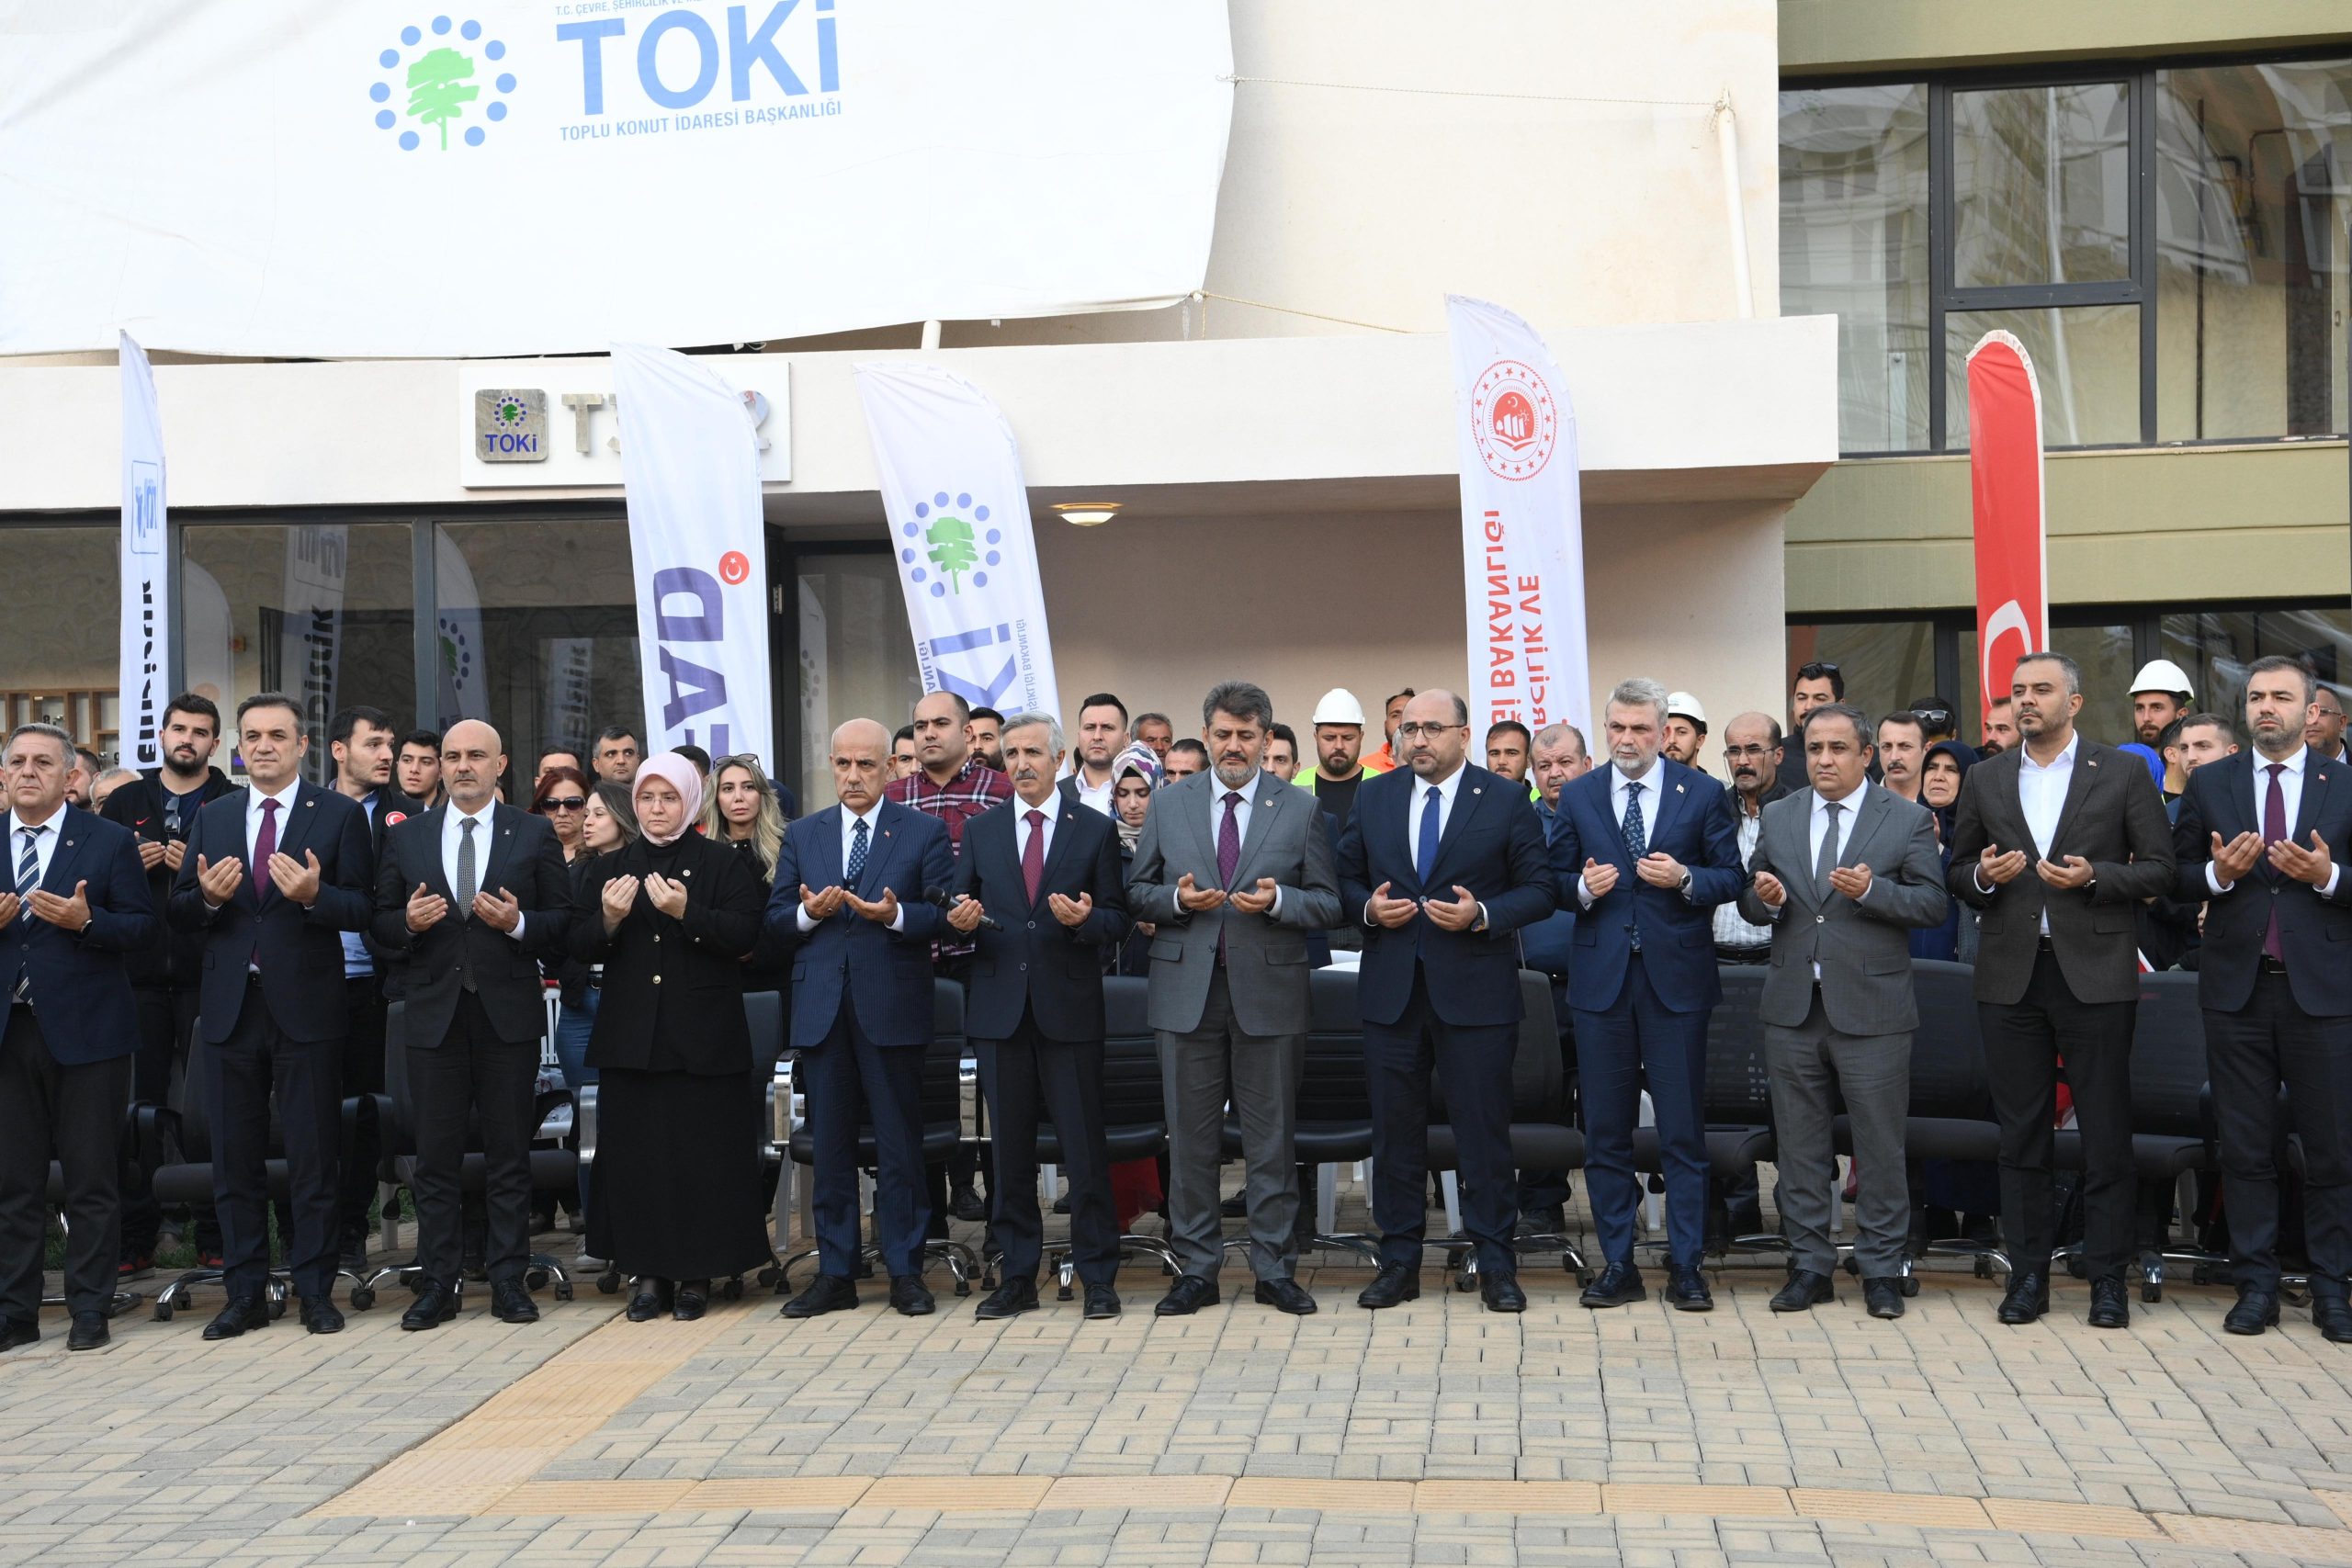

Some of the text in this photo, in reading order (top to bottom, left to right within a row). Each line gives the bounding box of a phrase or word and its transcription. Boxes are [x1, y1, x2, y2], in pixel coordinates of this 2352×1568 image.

[560, 97, 842, 141] TOPLU KONUT İDARESİ BAŞKANLIĞI
